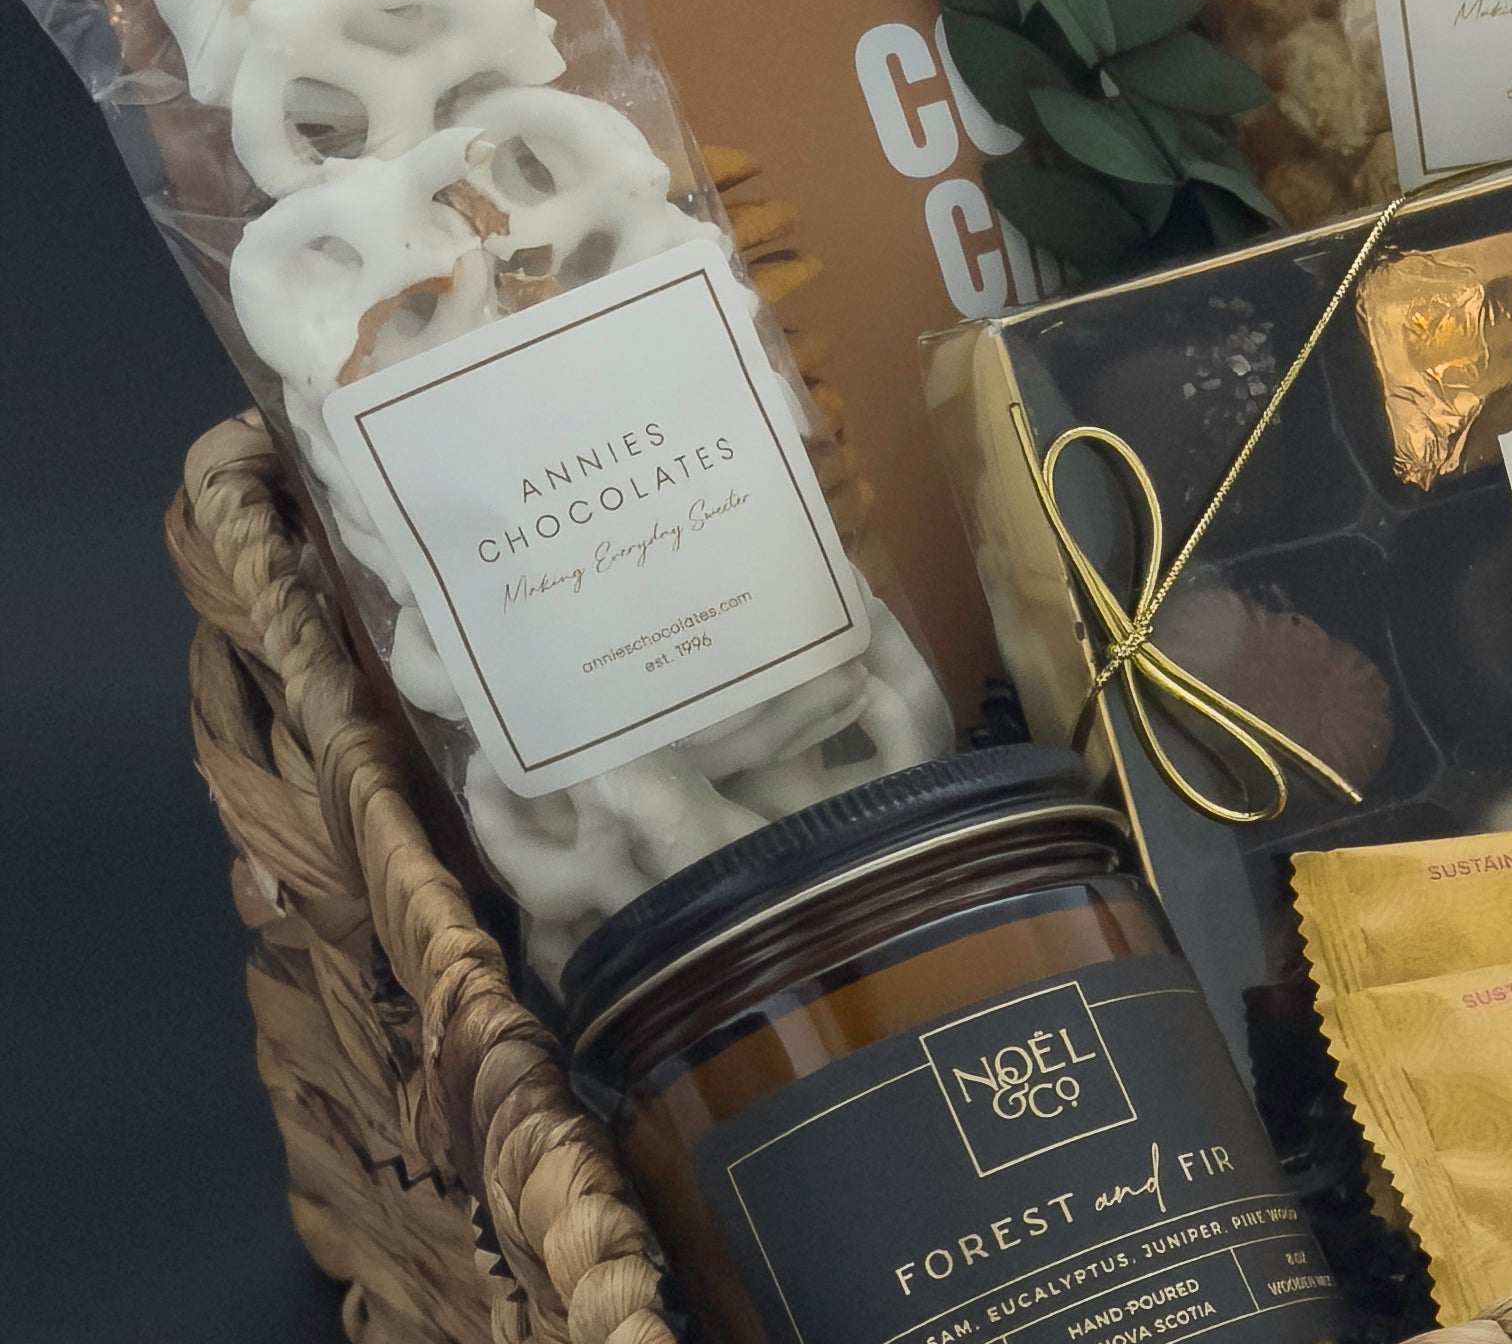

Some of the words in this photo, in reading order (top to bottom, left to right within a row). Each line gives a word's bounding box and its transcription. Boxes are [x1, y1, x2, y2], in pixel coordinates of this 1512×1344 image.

[478, 437, 734, 563] CHOCOLATES
[523, 423, 665, 503] ANNIES
[504, 567, 585, 614] Making
[594, 521, 684, 573] Everyday
[582, 591, 752, 673] annieschocolates.com
[676, 632, 712, 657] 1996
[952, 1028, 1096, 1103] NOËL
[895, 1193, 1074, 1295] FOREST
[1094, 1142, 1167, 1213] and
[1177, 1145, 1235, 1182] FIR
[1231, 1210, 1266, 1230] PINE
[1154, 1301, 1217, 1333] SCOTIA
